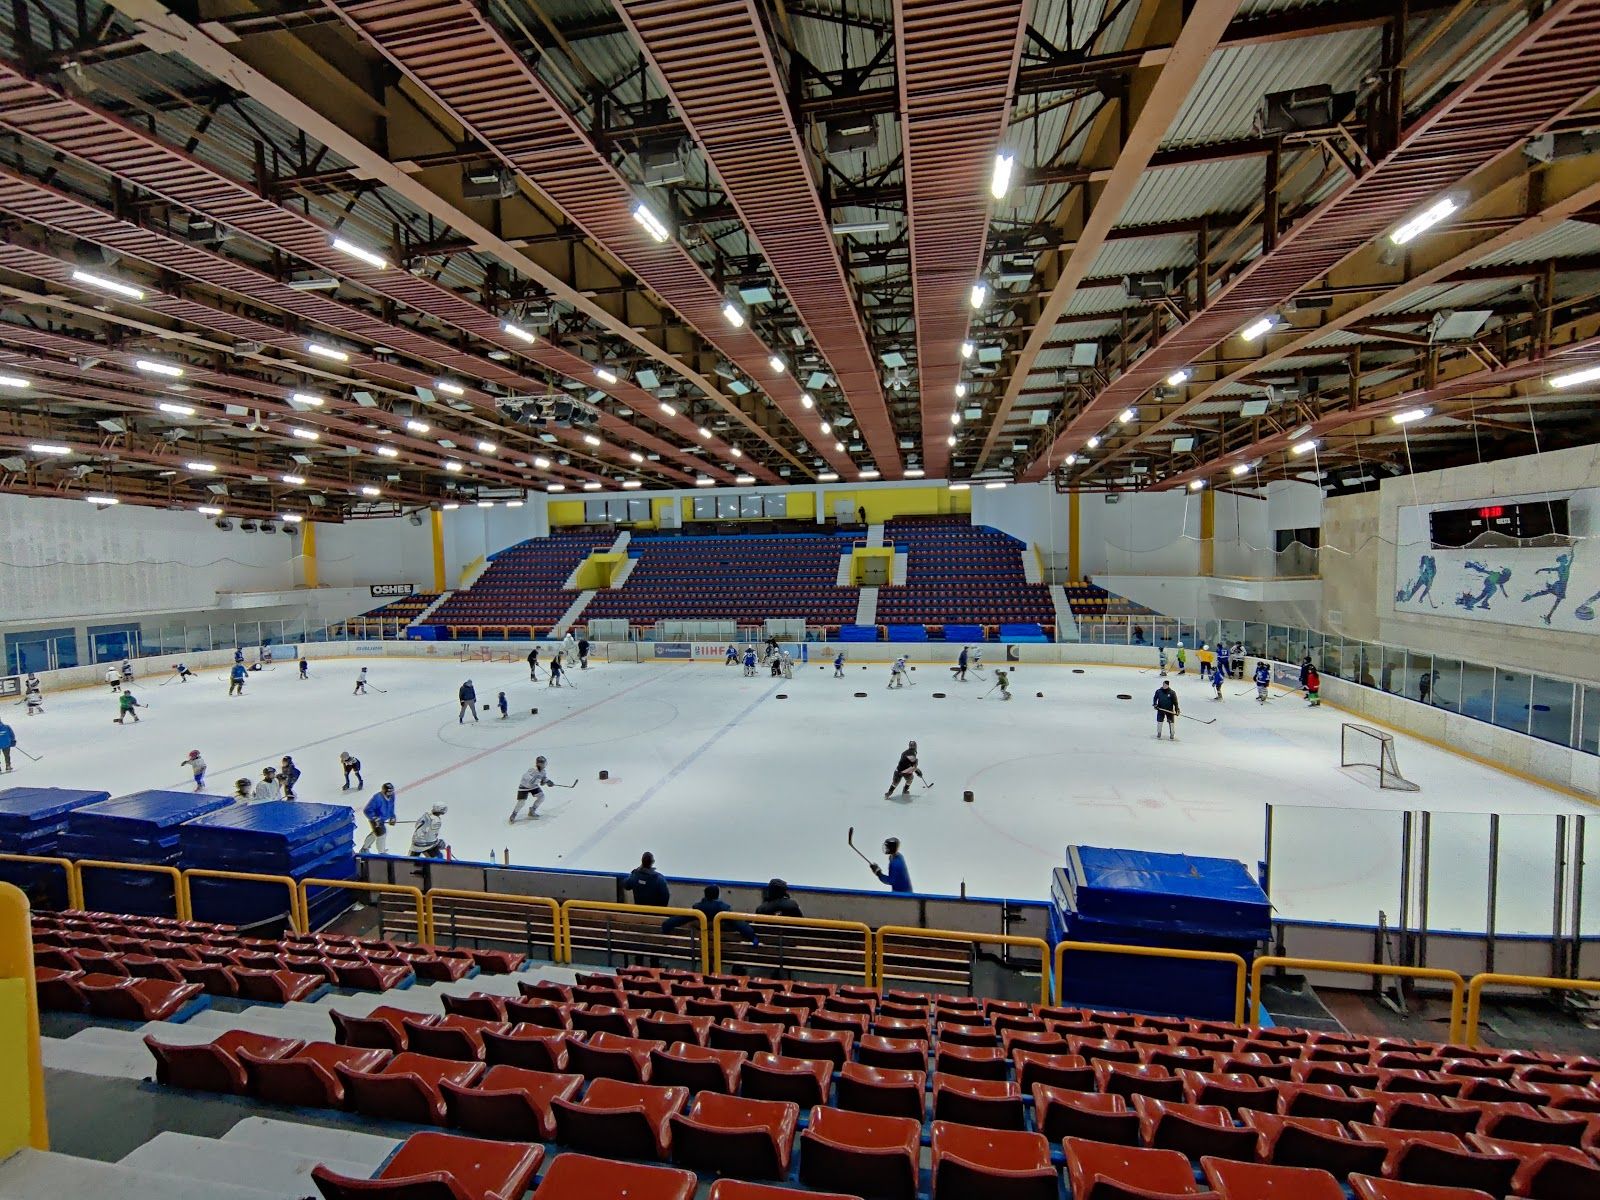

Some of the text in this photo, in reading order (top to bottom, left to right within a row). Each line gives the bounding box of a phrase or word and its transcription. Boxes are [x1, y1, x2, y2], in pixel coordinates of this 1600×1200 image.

[372, 585, 412, 594] OSHEE
[701, 646, 725, 656] IIHF
[0, 679, 16, 693] E
